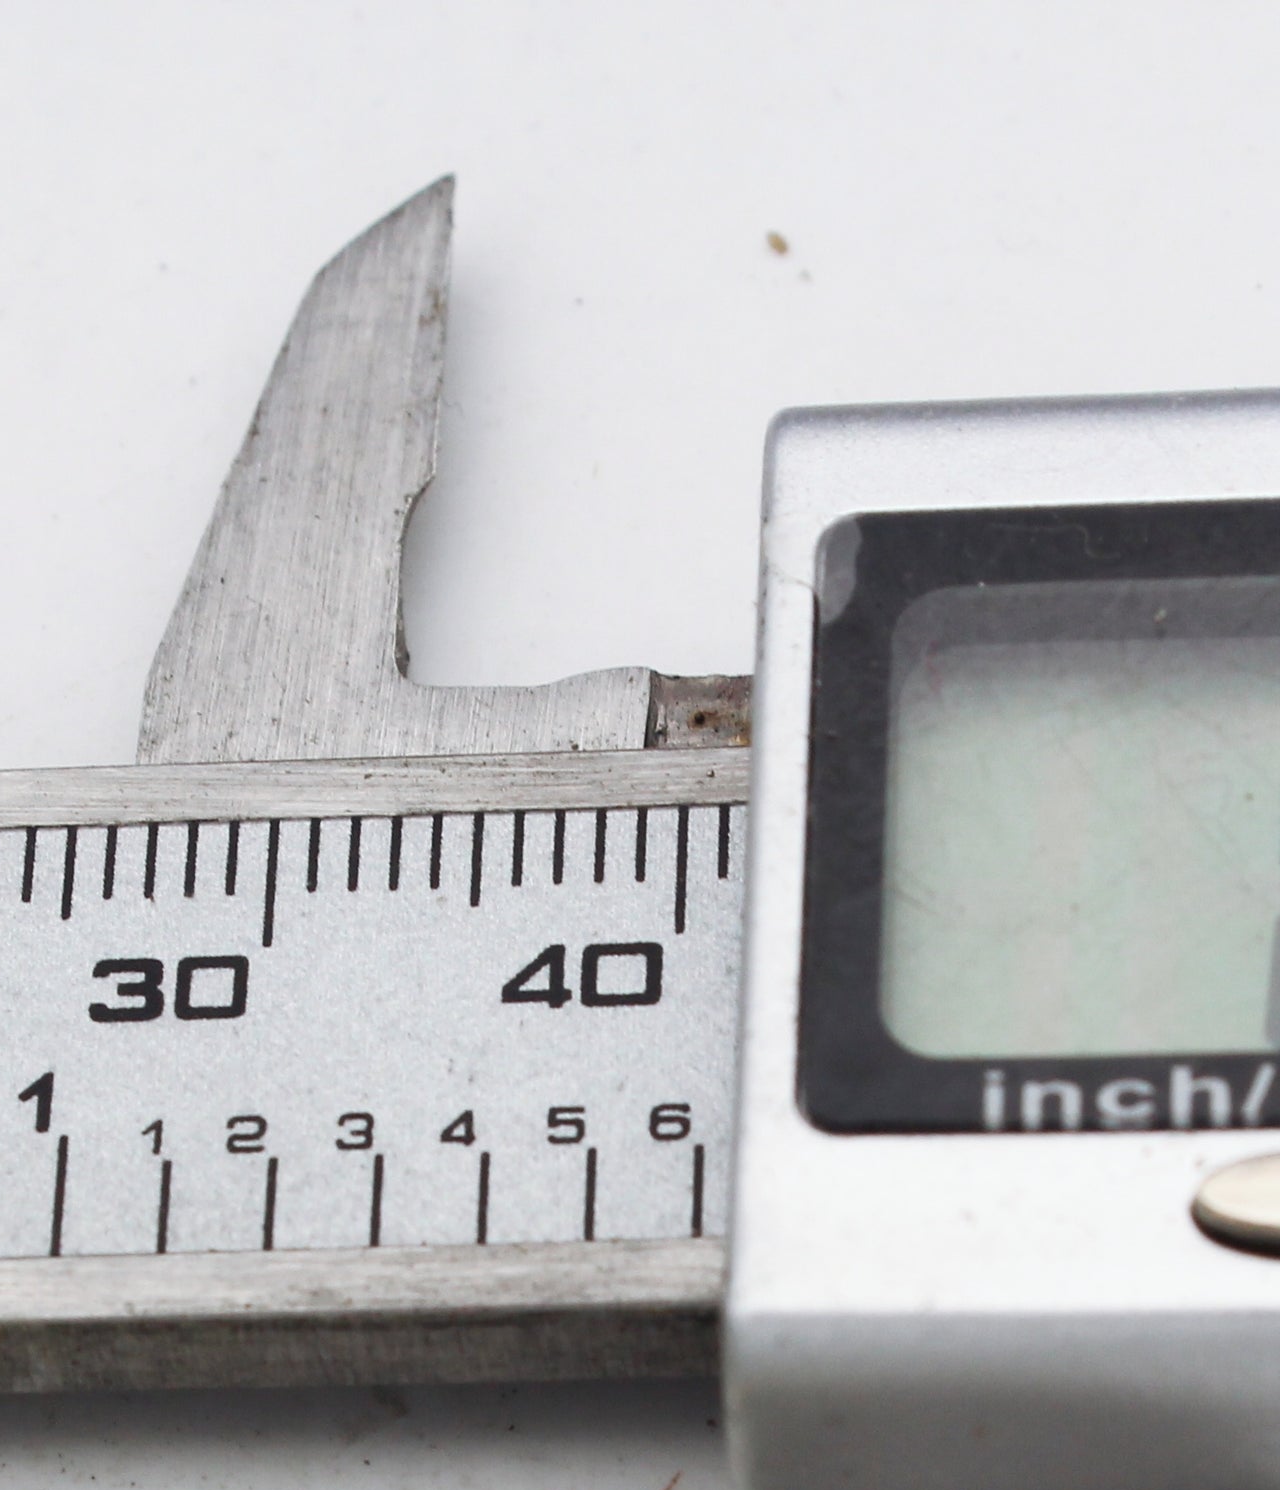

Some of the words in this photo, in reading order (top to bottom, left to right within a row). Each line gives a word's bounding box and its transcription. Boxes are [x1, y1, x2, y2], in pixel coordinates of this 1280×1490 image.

[88, 955, 249, 1024] 30
[500, 940, 663, 1009] 40
[18, 1071, 55, 1134] 1
[140, 1119, 163, 1155] 1
[226, 1115, 268, 1154] 2
[334, 1112, 375, 1151] 3
[440, 1109, 476, 1147] 4
[546, 1106, 586, 1145] 5
[648, 1103, 691, 1142] 6
